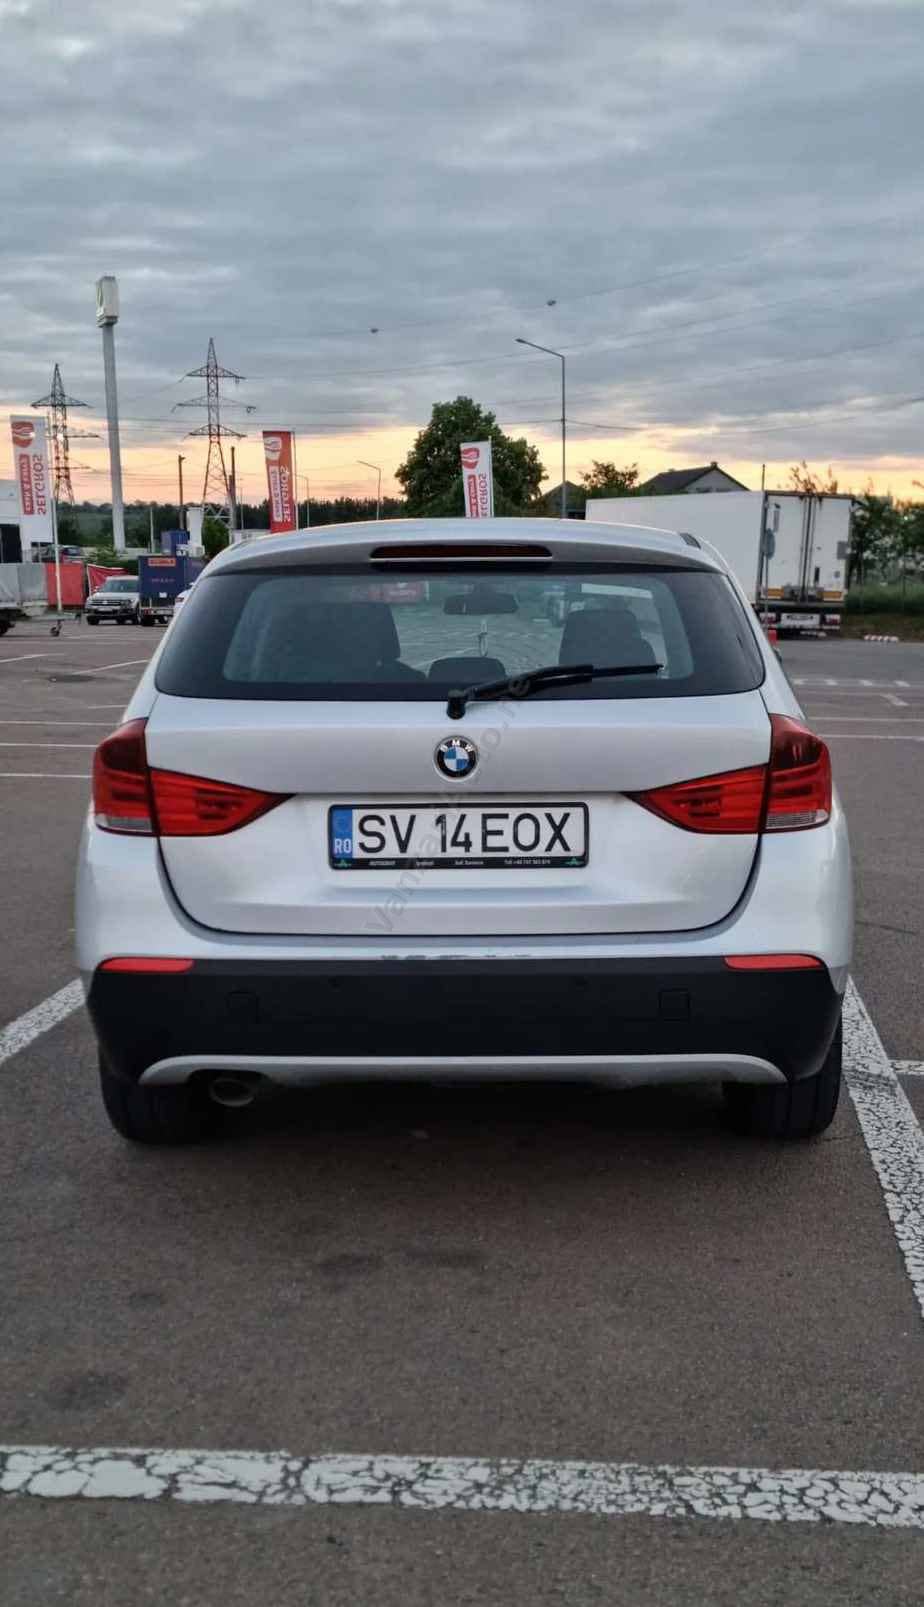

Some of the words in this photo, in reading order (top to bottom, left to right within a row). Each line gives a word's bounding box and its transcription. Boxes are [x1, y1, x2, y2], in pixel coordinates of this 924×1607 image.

[440, 739, 473, 752] BMW
[358, 814, 416, 853] SV
[334, 838, 351, 854] RO
